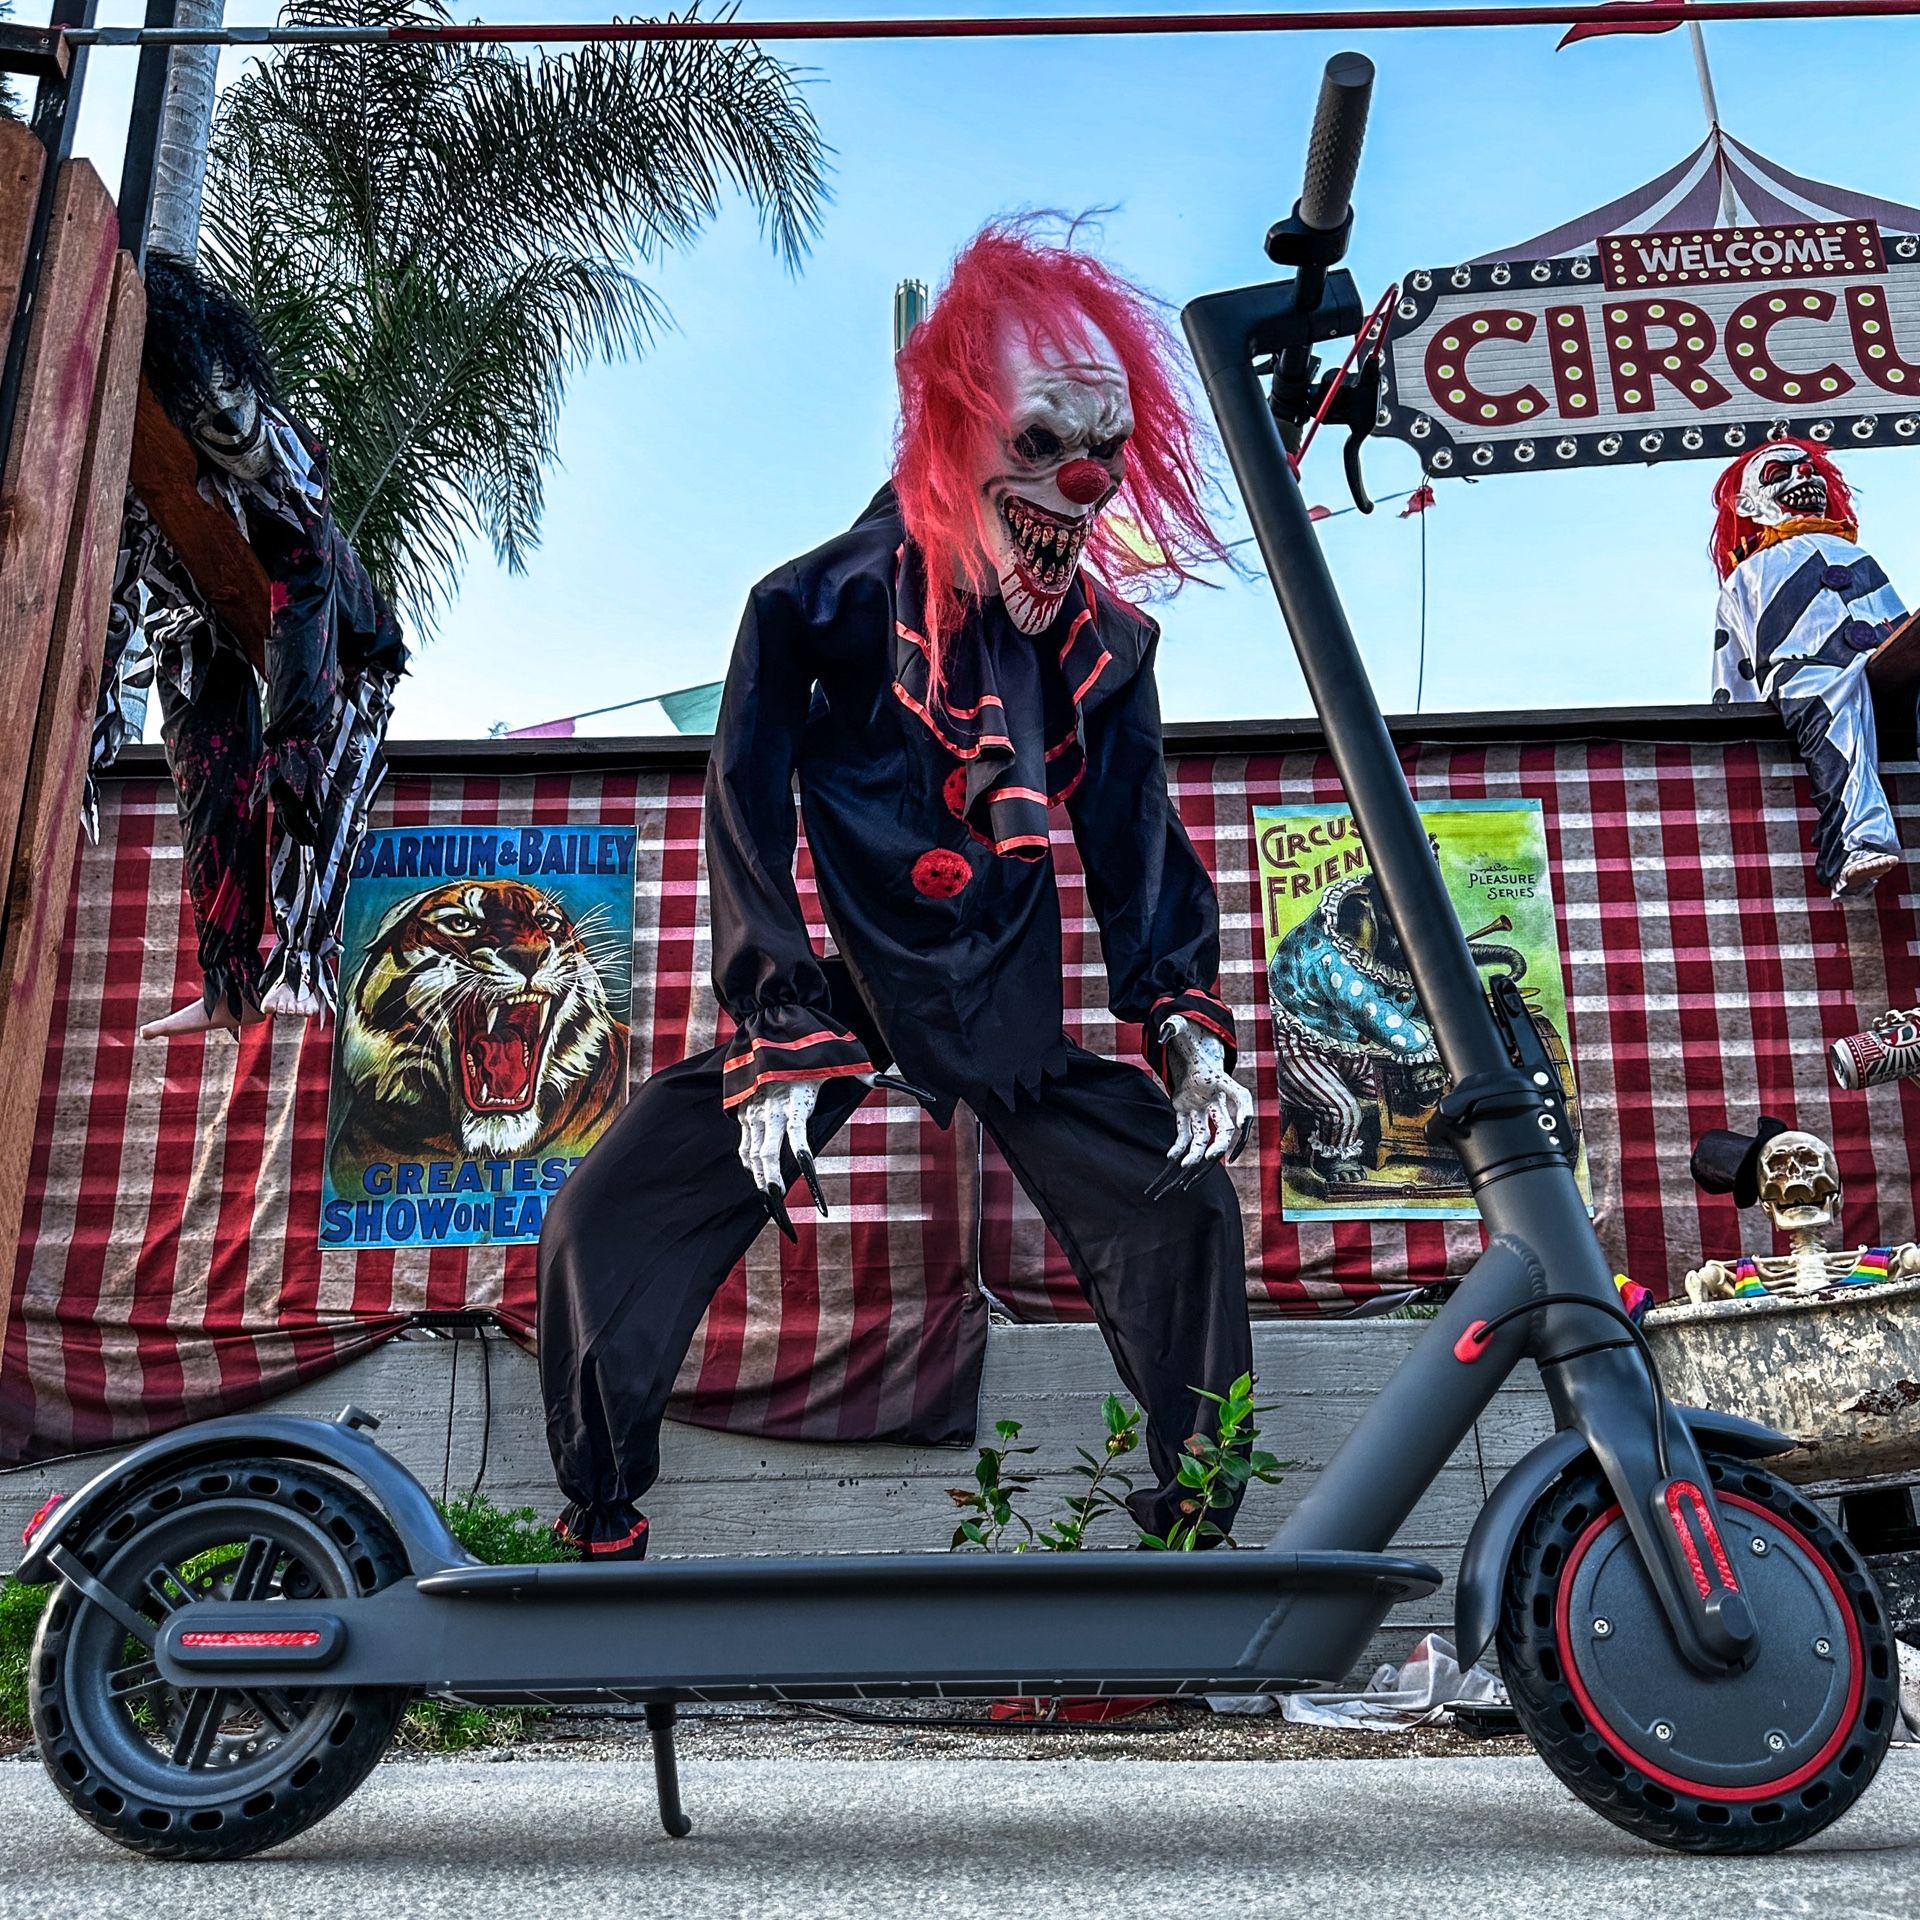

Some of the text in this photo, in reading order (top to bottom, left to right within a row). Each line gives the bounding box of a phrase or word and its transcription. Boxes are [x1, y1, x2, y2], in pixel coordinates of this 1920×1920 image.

[1638, 236, 1846, 274] WELCOME
[352, 829, 637, 878] BARNUM & BAILEY
[1267, 846, 1364, 937] FRIEN
[1468, 873, 1536, 888] PLEASURE
[1487, 887, 1535, 900] SERIES
[321, 1198, 457, 1242] SHOW
[454, 1203, 490, 1232] ON
